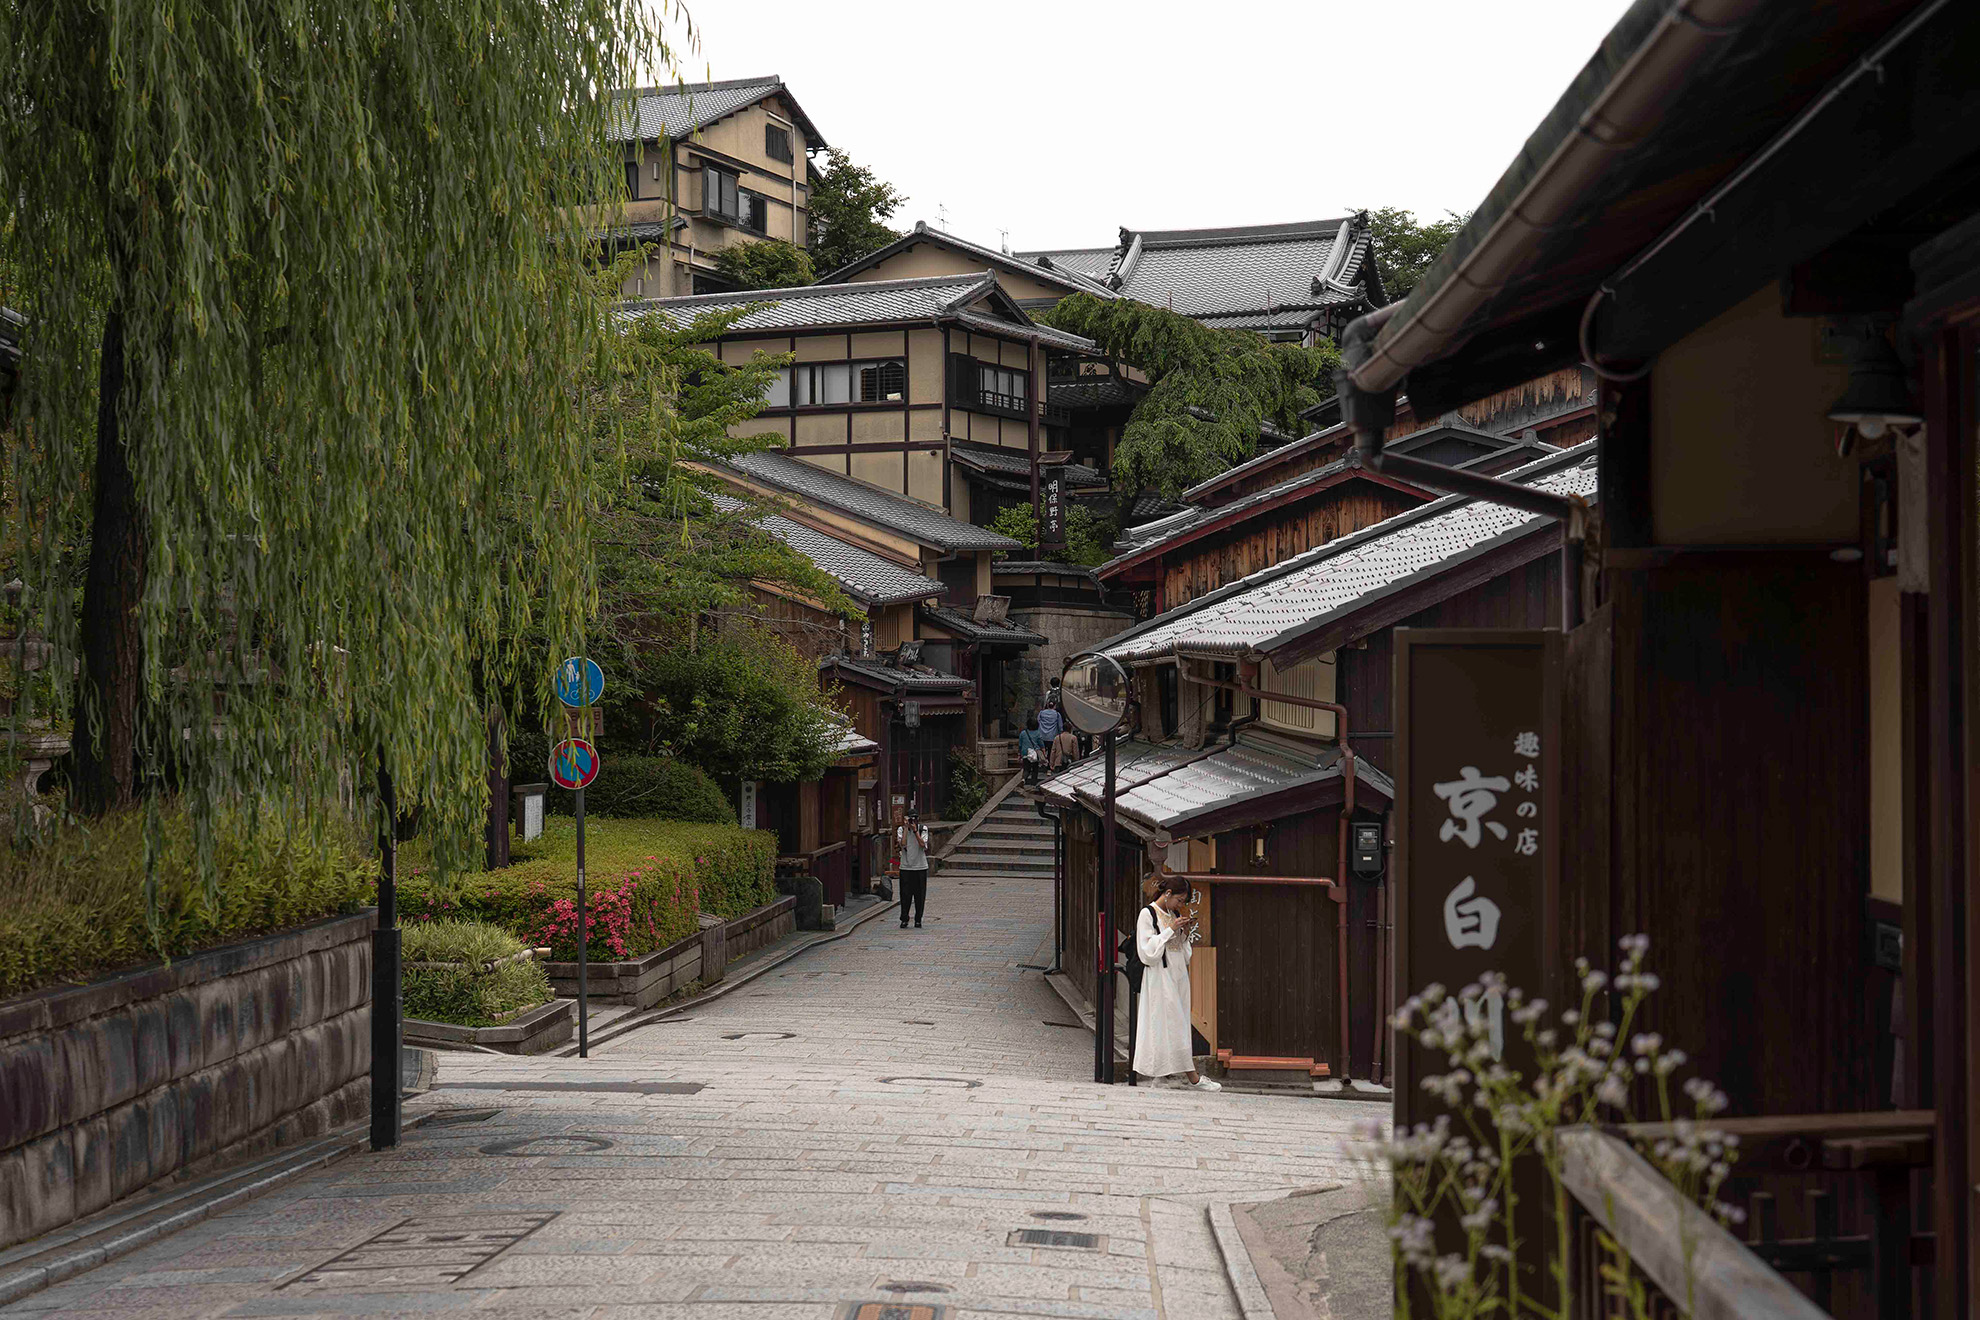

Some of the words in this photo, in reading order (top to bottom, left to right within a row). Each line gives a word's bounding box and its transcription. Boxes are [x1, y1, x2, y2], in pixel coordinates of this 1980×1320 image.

[1048, 479, 1059, 532] 明保野亭
[1513, 731, 1540, 856] 趣味の店
